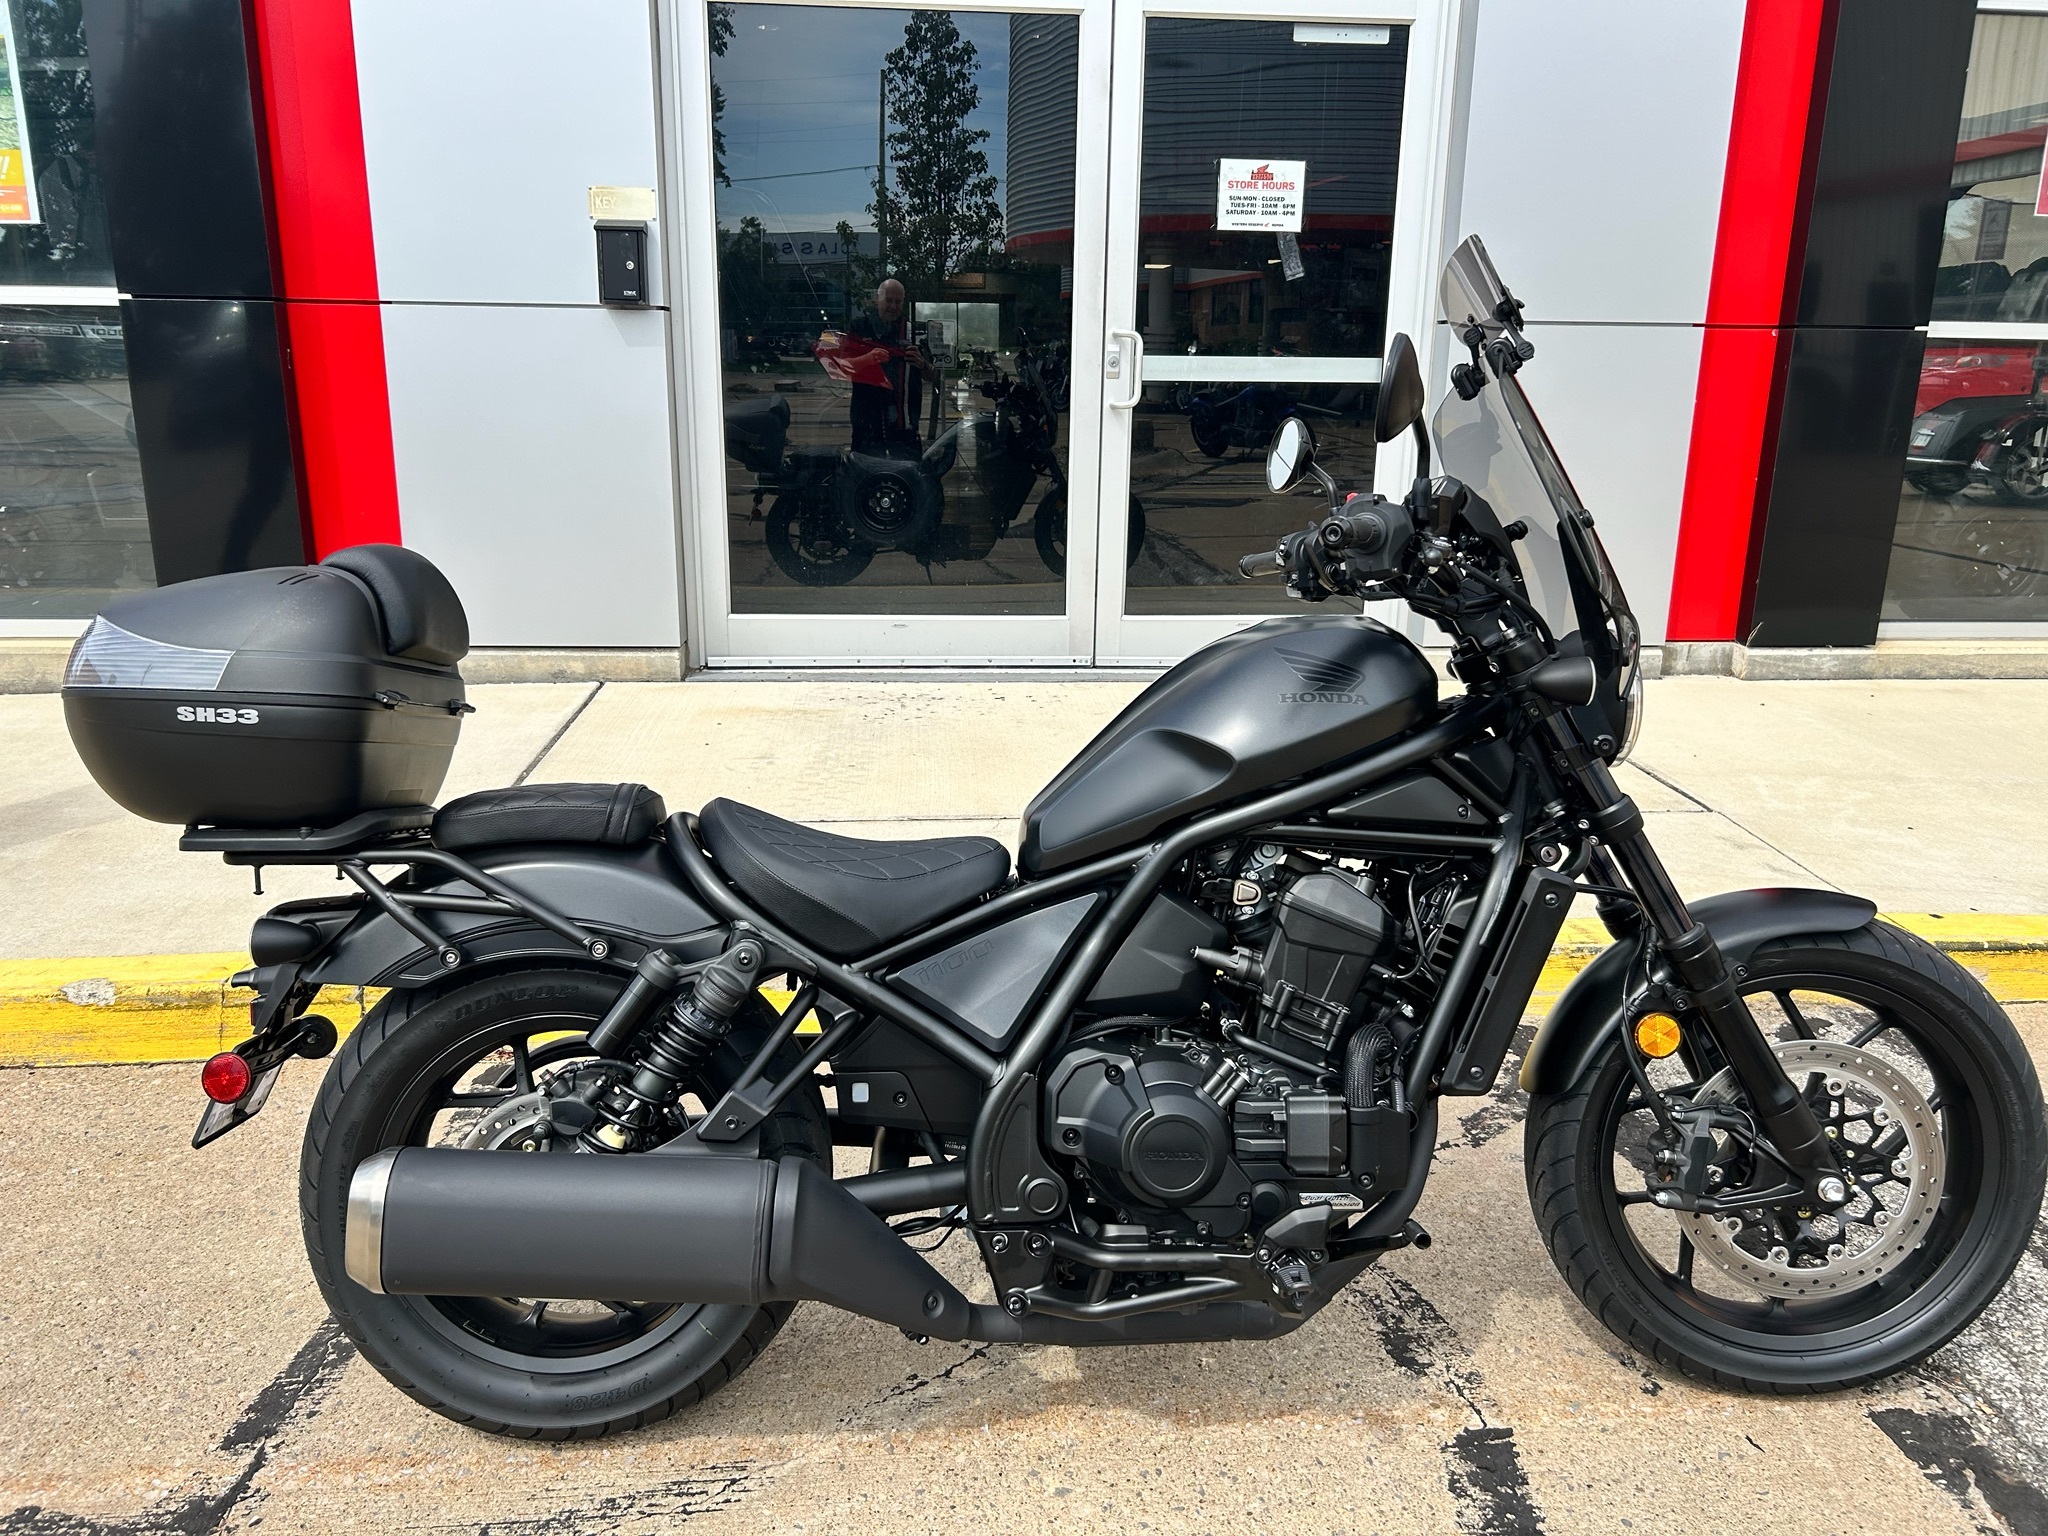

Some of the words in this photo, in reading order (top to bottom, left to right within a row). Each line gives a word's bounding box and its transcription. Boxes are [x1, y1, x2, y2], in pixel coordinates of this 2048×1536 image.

[1228, 180, 1259, 189] STORE
[1262, 181, 1295, 190] HOURS
[595, 197, 617, 209] KEY
[1278, 692, 1371, 706] HONDA
[176, 706, 260, 725] SH33
[913, 938, 995, 985] 1100
[454, 985, 580, 1020] DUNLOP
[1143, 1151, 1205, 1161] HONDA
[570, 1377, 649, 1412] D428
